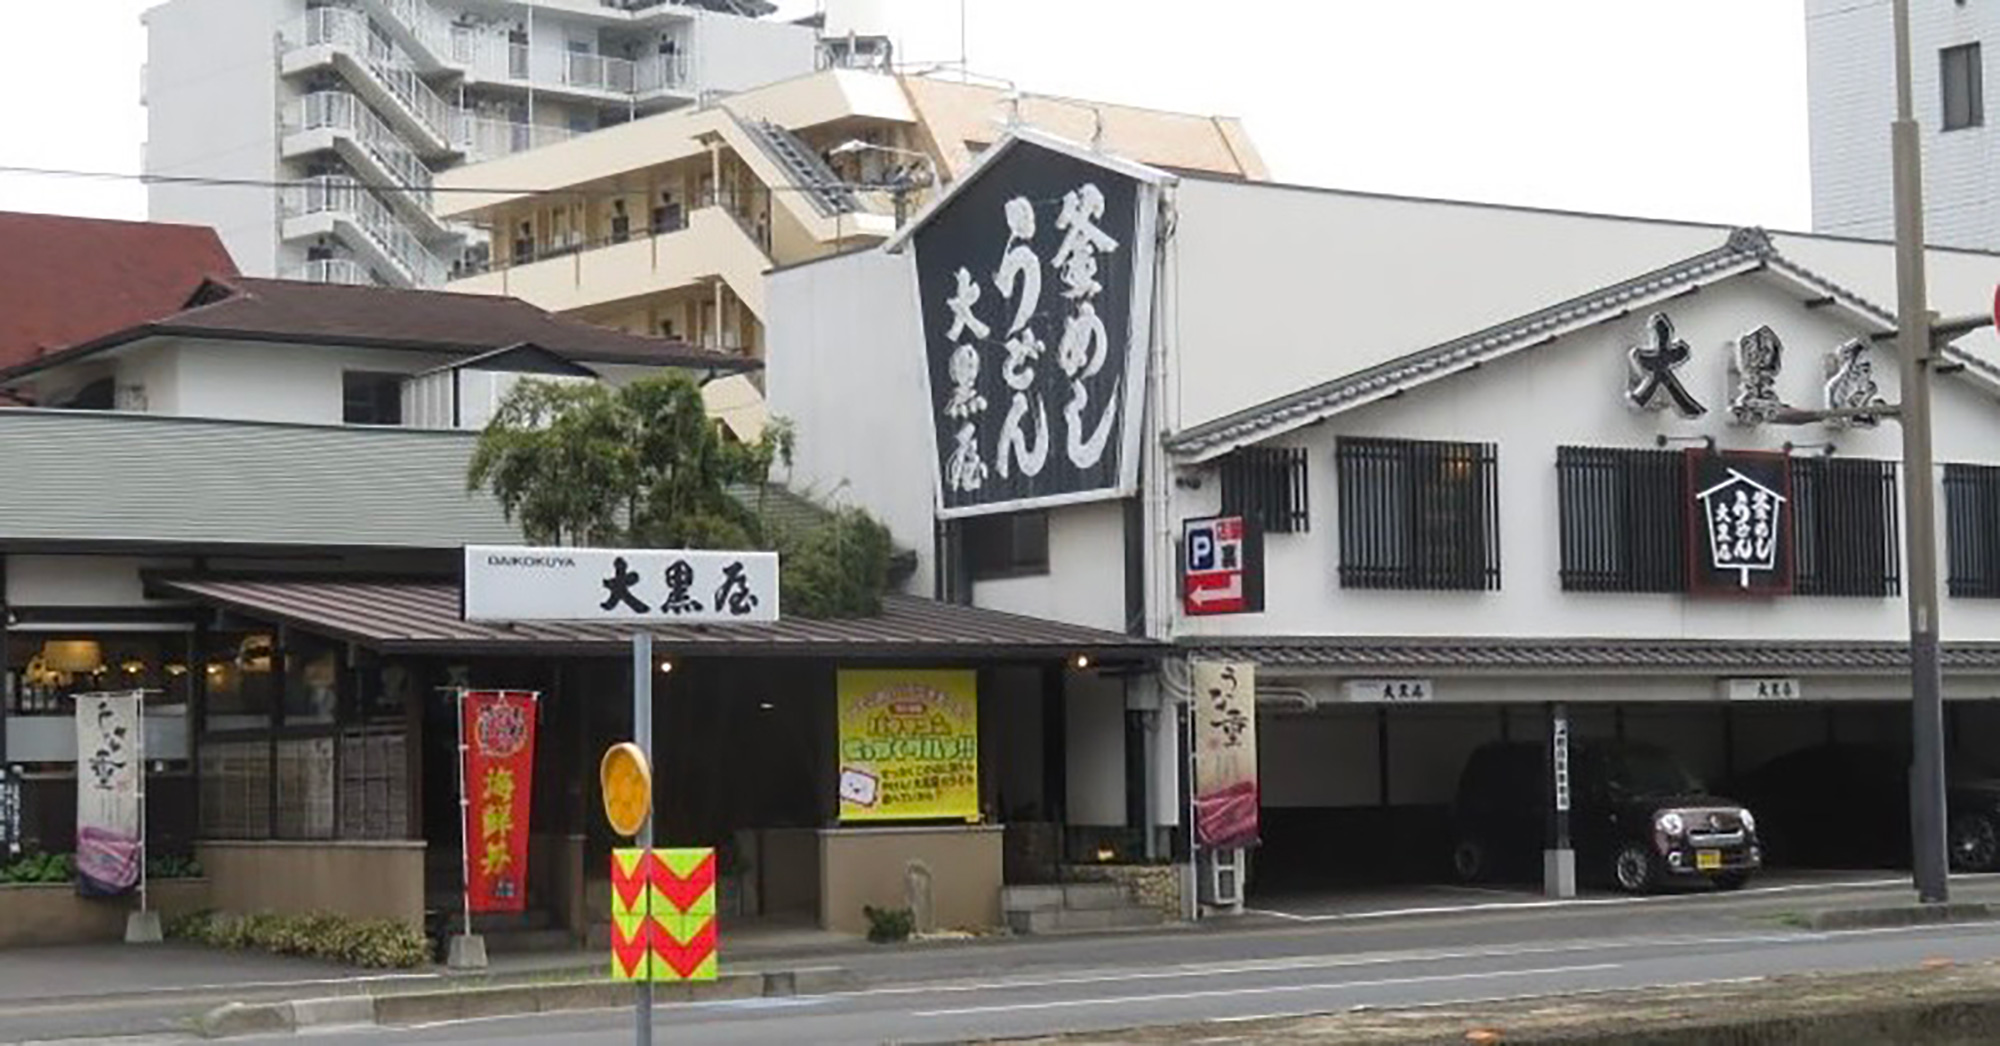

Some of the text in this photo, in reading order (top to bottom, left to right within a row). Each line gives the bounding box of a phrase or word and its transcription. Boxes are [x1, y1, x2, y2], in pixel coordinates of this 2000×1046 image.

[993, 196, 1050, 479] うどん
[1051, 183, 1121, 469] 釜めし
[944, 266, 990, 492] 大黒屋
[488, 556, 575, 567] DAIKOKUYA
[1192, 536, 1211, 567] P
[1732, 489, 1753, 560] うどん
[600, 556, 758, 615] 大黒屋
[1209, 666, 1249, 747] うな重
[481, 765, 515, 876] 海鮮丼
